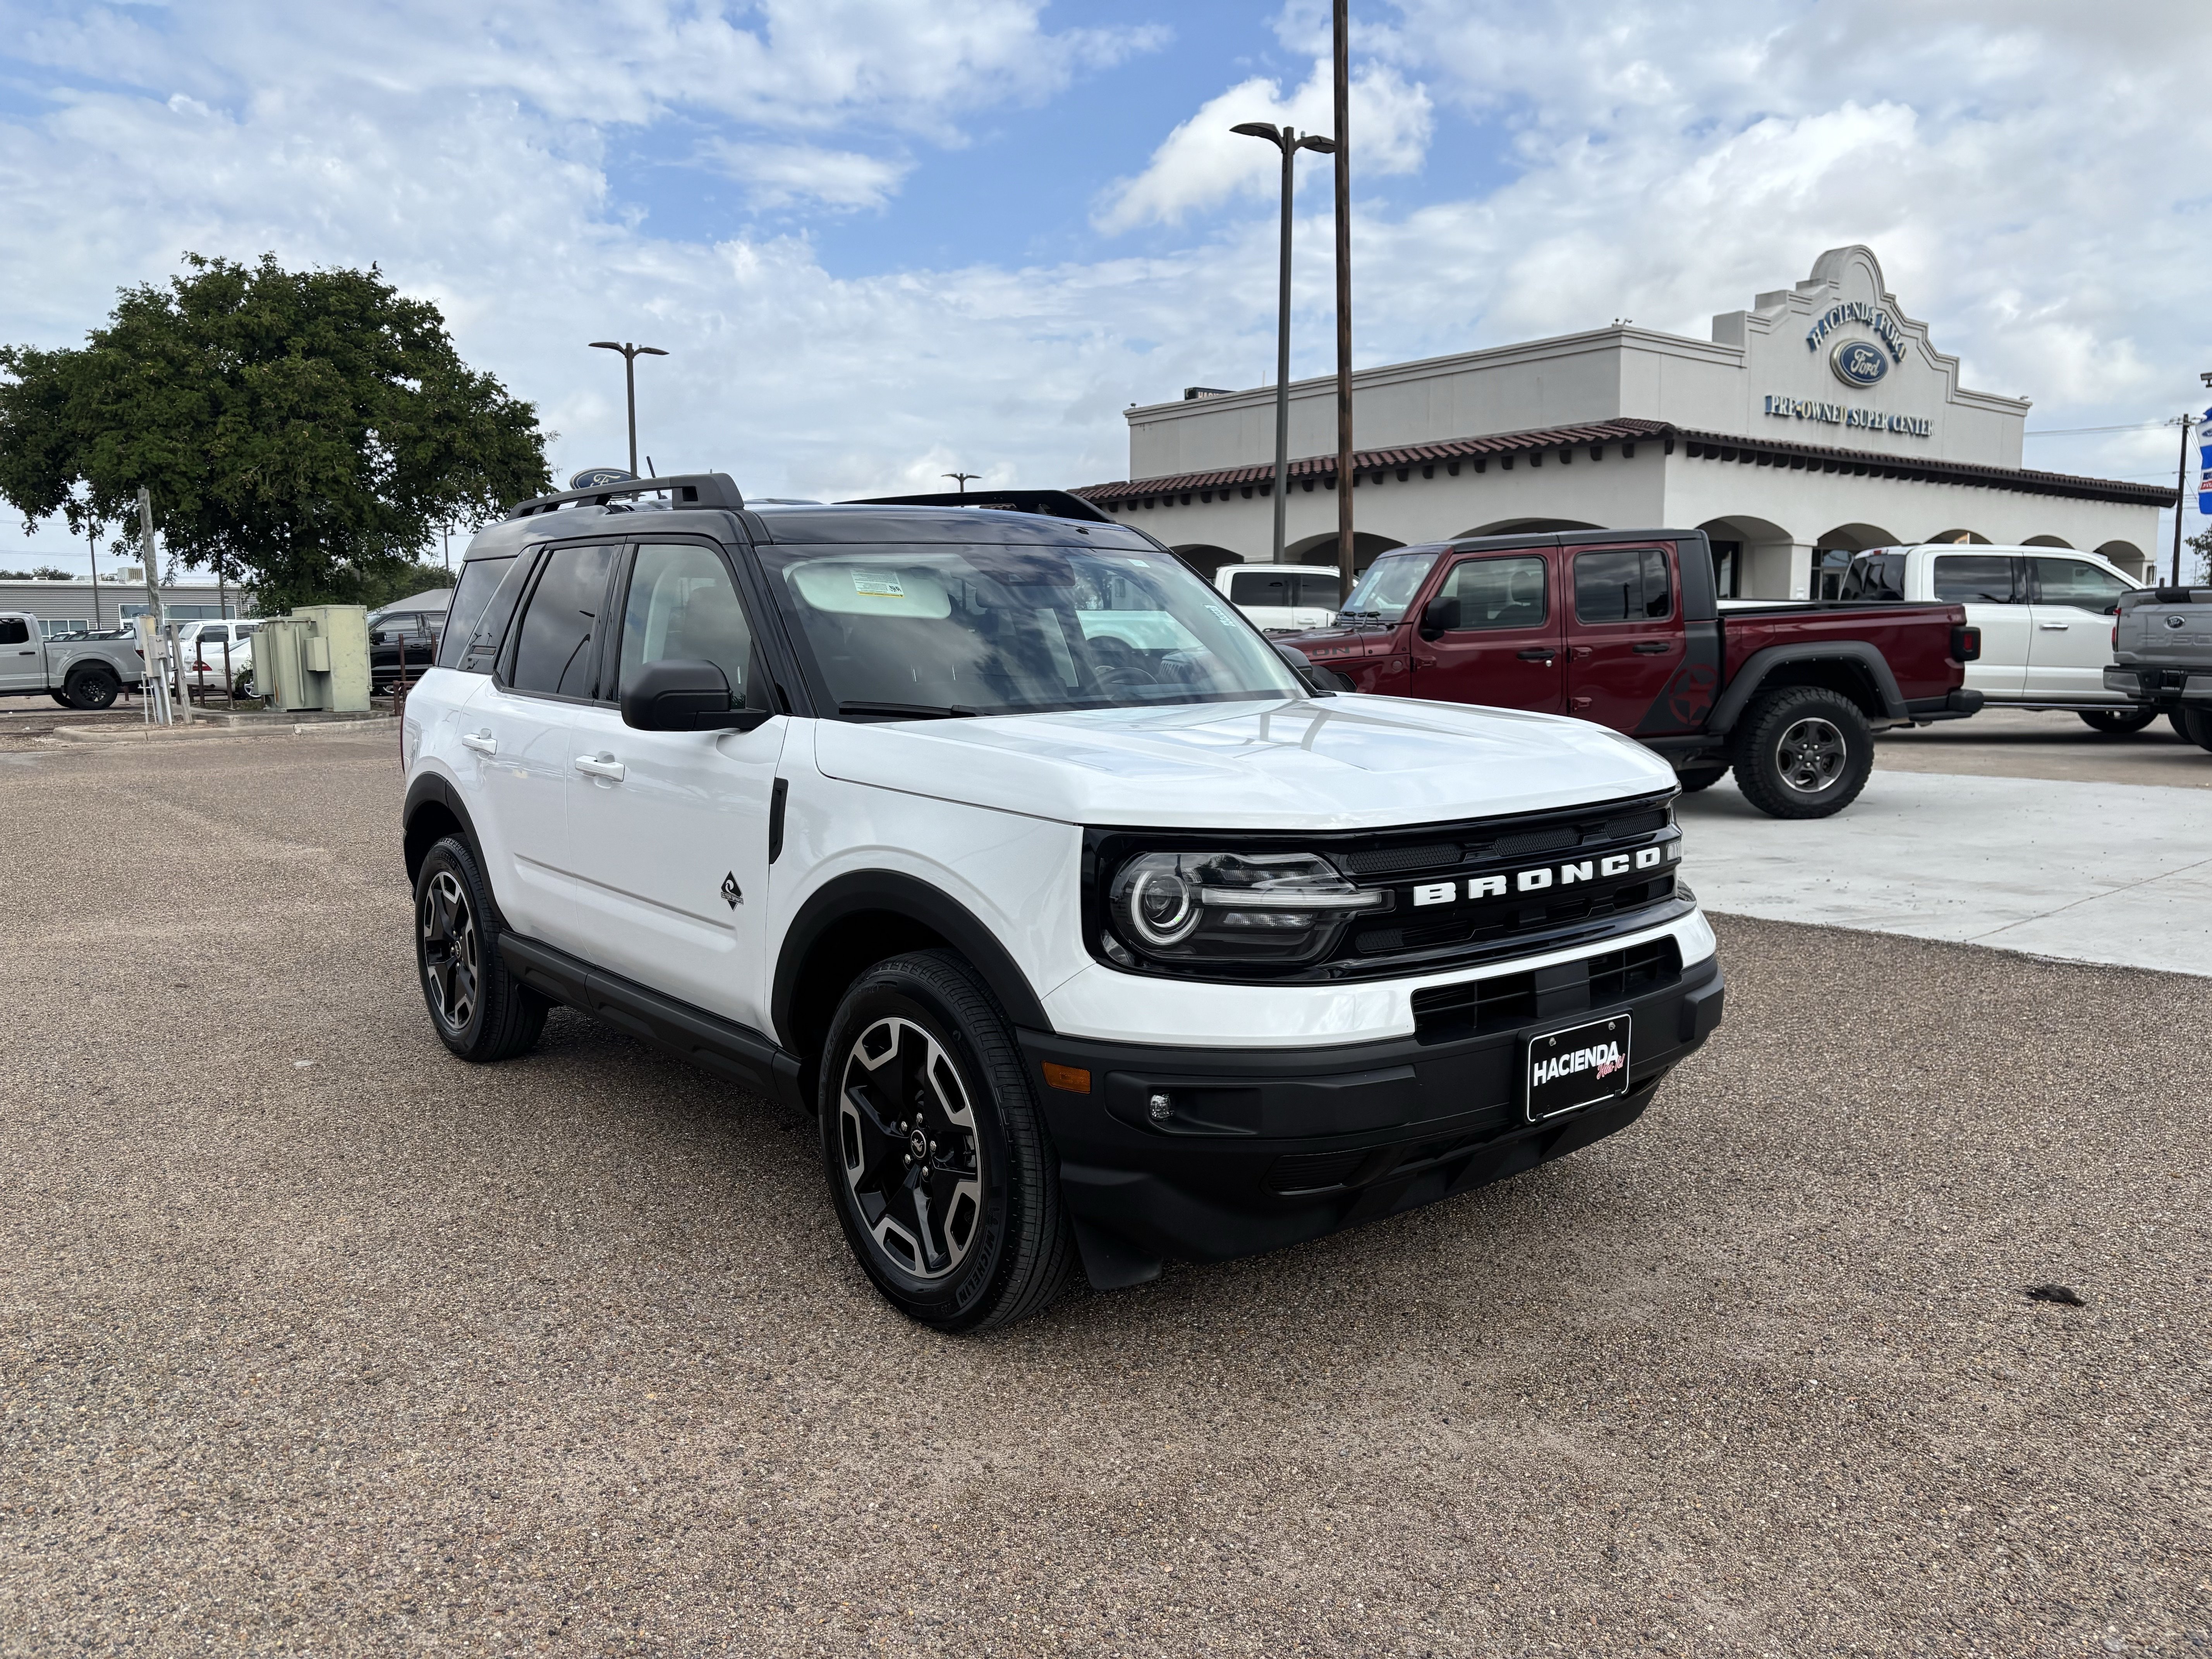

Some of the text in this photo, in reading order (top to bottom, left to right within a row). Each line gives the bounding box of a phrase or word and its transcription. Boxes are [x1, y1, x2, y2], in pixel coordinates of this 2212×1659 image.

[1807, 302, 1906, 363] HACIENDA FORD
[1850, 349, 1881, 377] Ford
[1767, 395, 1935, 436] PRE-OWNED SUPER CENTER
[1413, 847, 1661, 906] BRONCO
[1534, 1041, 1619, 1087] HACIENDA
[958, 1230, 995, 1303] MICHELIN
